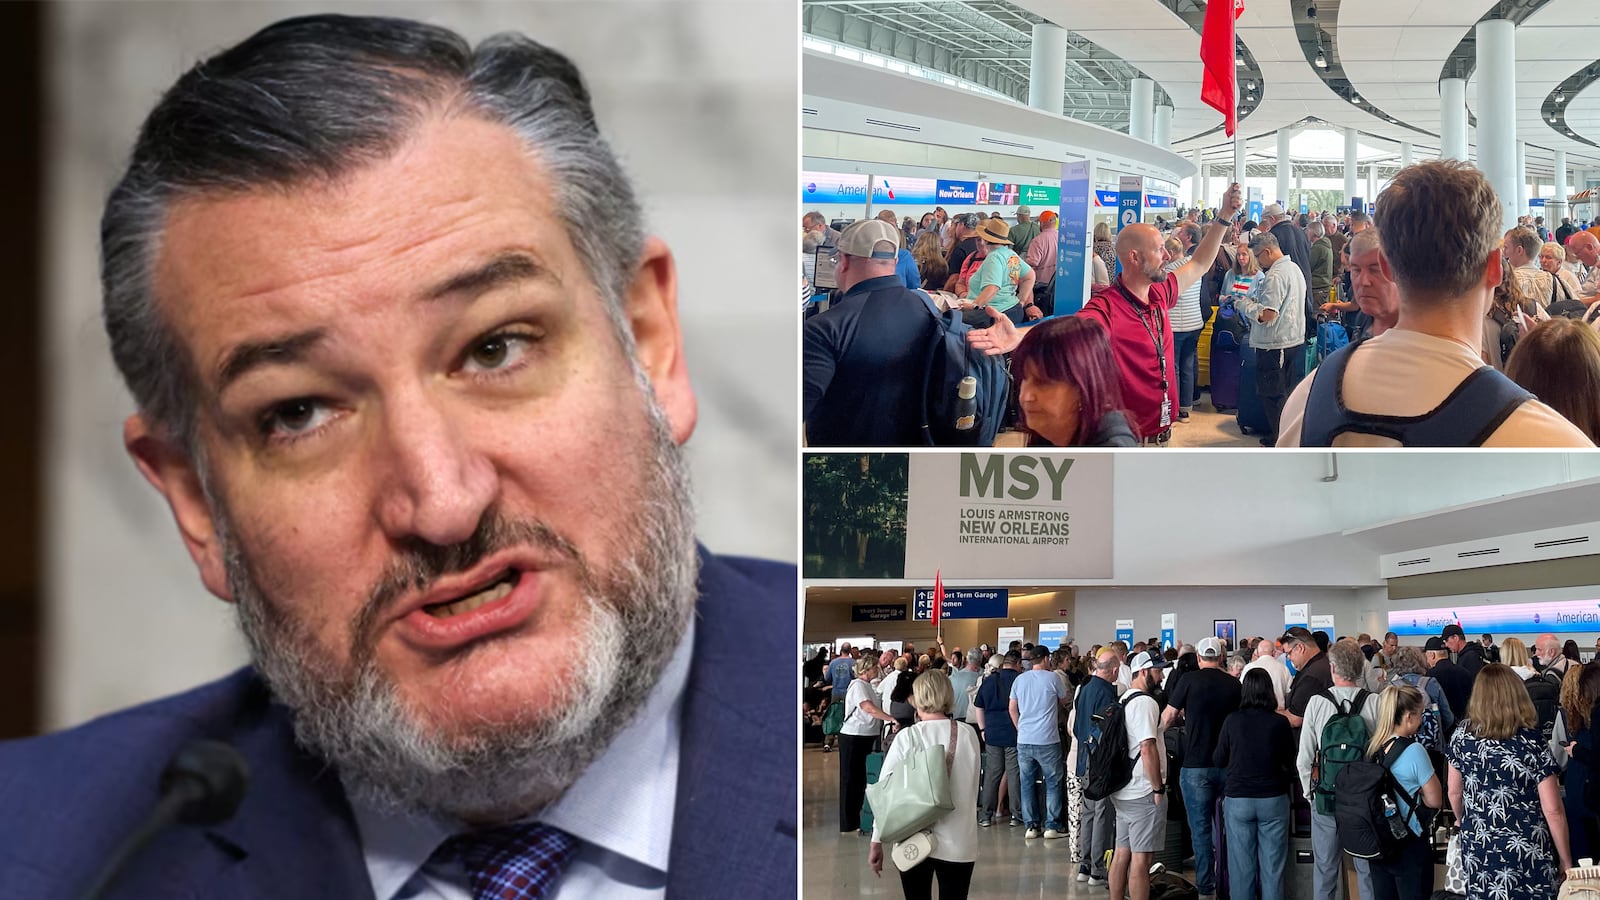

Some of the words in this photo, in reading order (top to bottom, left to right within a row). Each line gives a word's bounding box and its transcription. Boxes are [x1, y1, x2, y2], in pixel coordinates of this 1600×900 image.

[836, 183, 883, 197] Amerian
[939, 190, 954, 198] New
[954, 190, 974, 199] Orleans
[1126, 212, 1133, 224] 2
[960, 453, 1075, 501] MSY
[960, 508, 995, 519] LOUIS
[998, 510, 1070, 521] ARMSTRONG
[960, 520, 996, 534] NEW
[1000, 521, 1069, 536] ORLEANS
[959, 536, 1030, 545] INTERNATIONAL
[1032, 537, 1069, 545] AIRPORT
[1426, 617, 1454, 628] American
[1556, 612, 1599, 625] American
